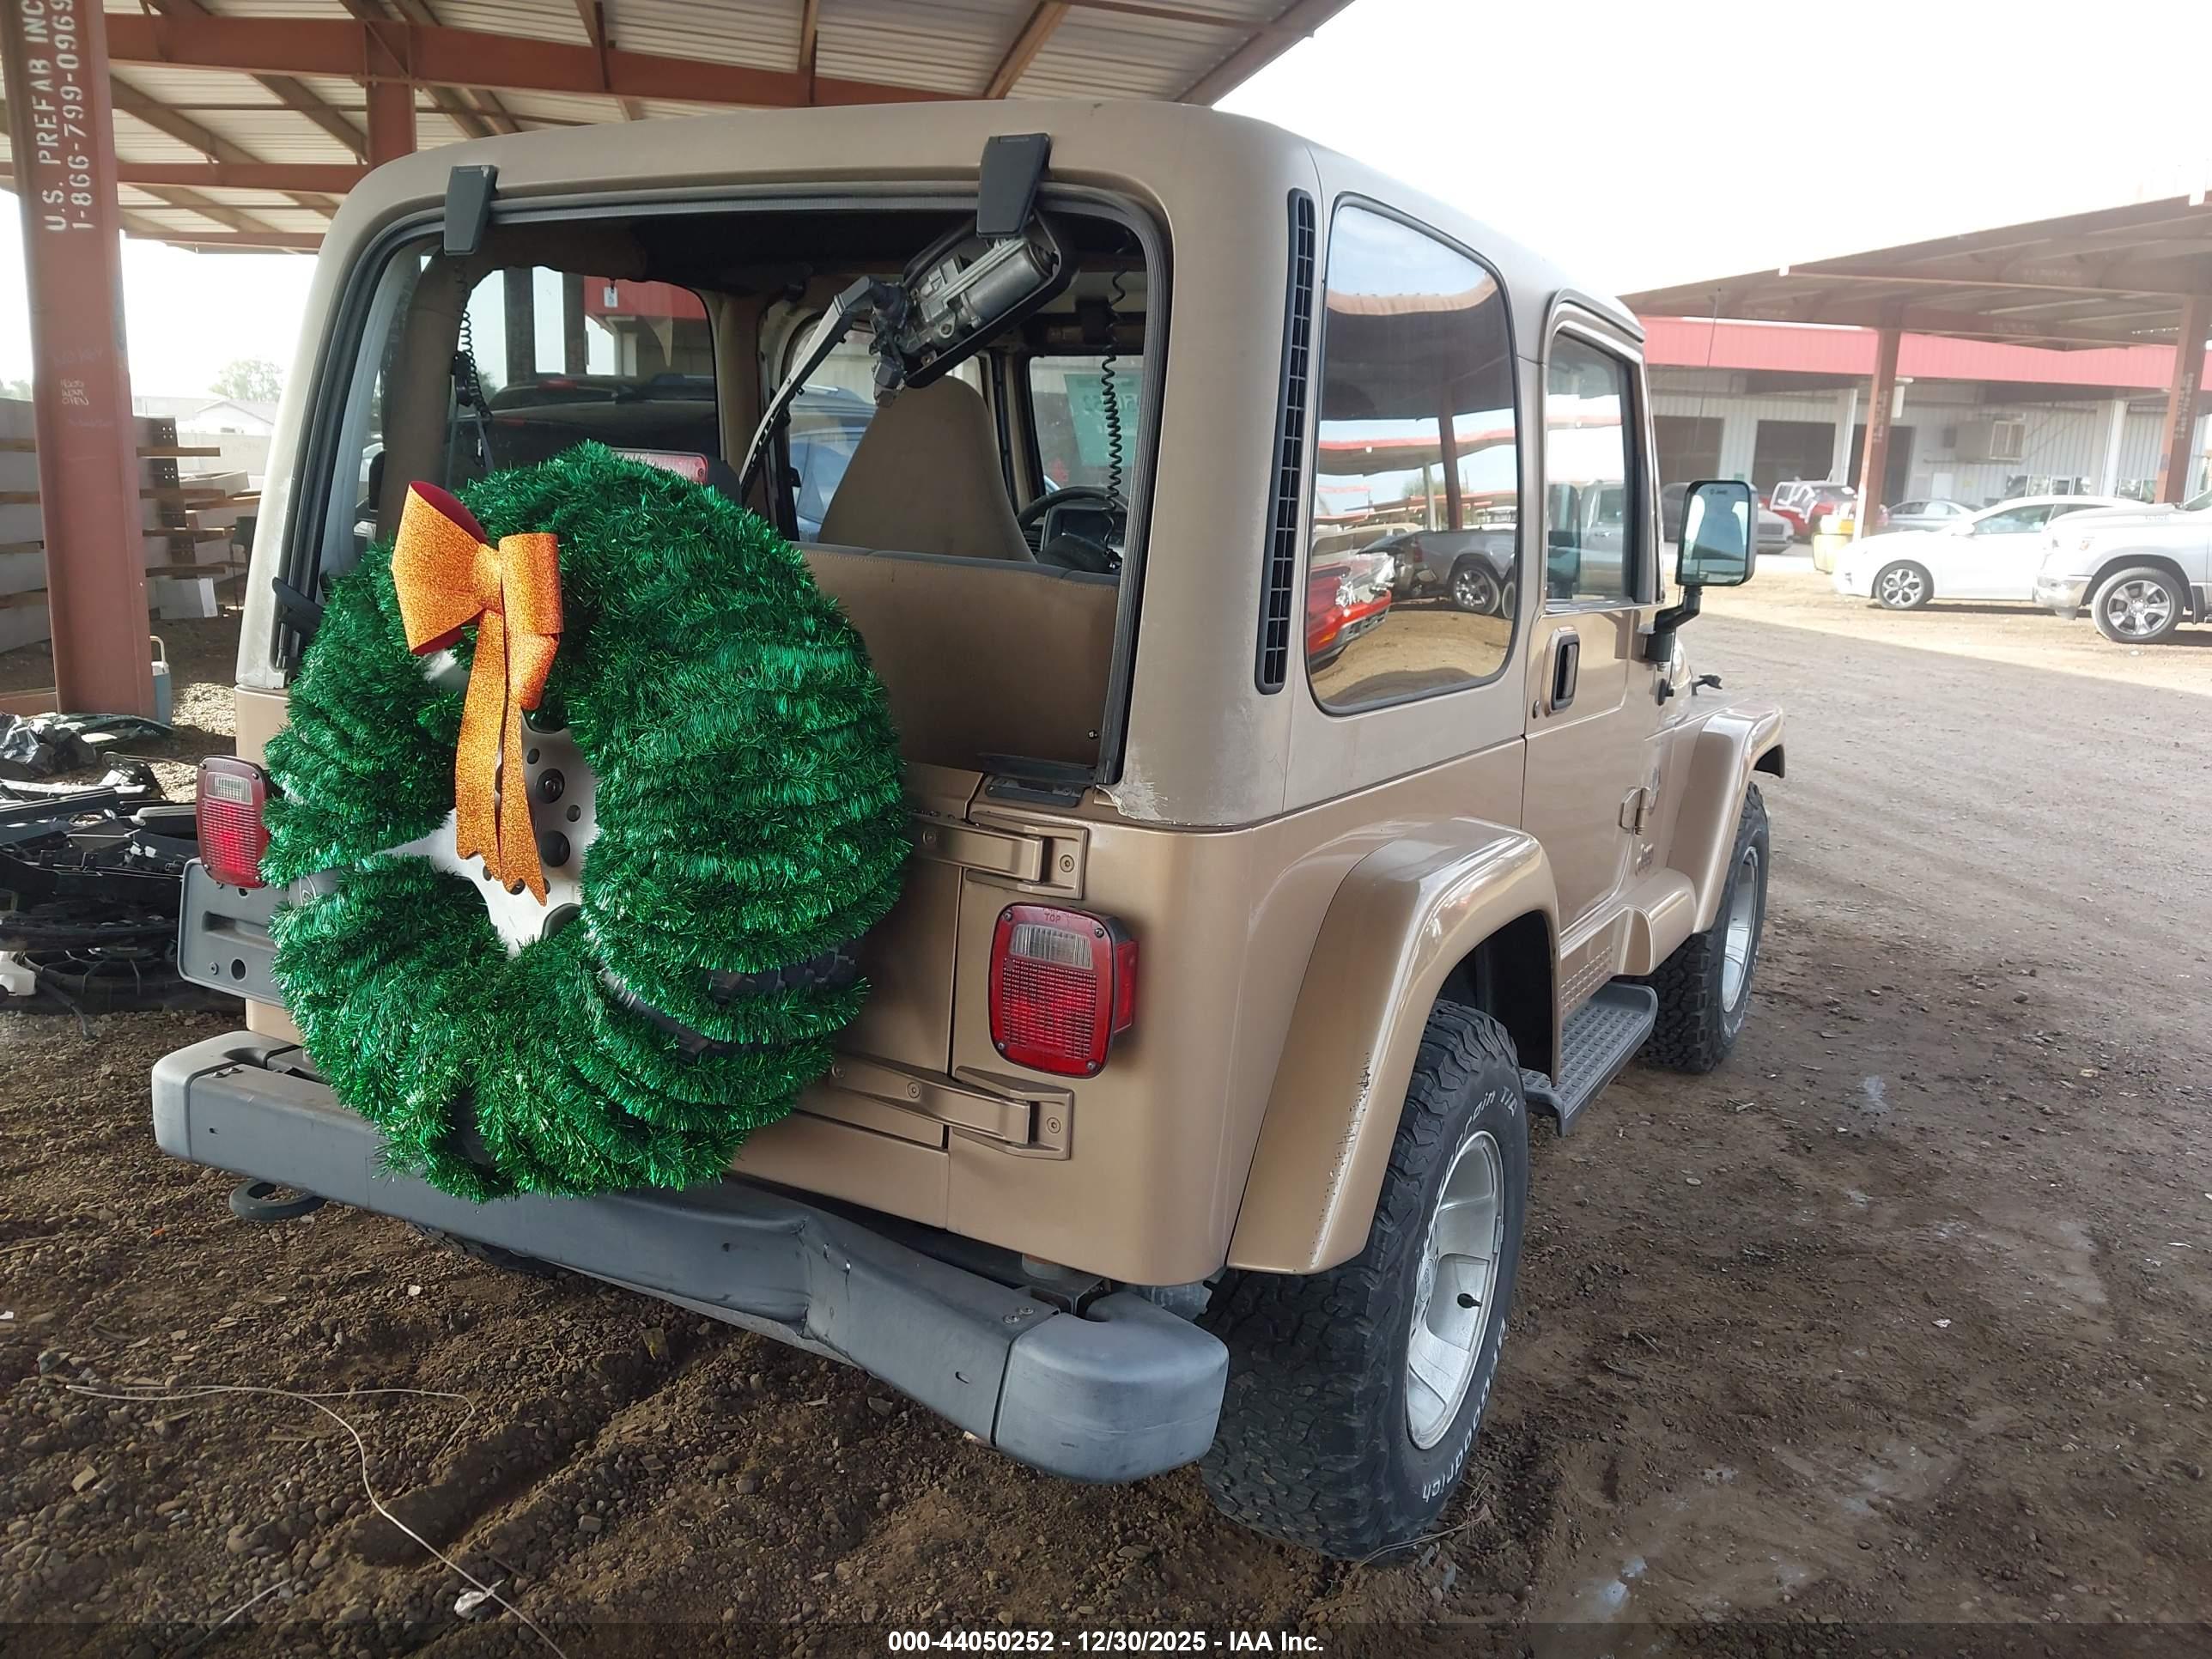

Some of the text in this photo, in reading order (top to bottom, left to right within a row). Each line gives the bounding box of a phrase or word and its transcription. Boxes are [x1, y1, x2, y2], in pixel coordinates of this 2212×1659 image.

[27, 58, 62, 165] PREFAB
[42, 180, 68, 231] U.S.
[1044, 912, 1061, 923] TOP
